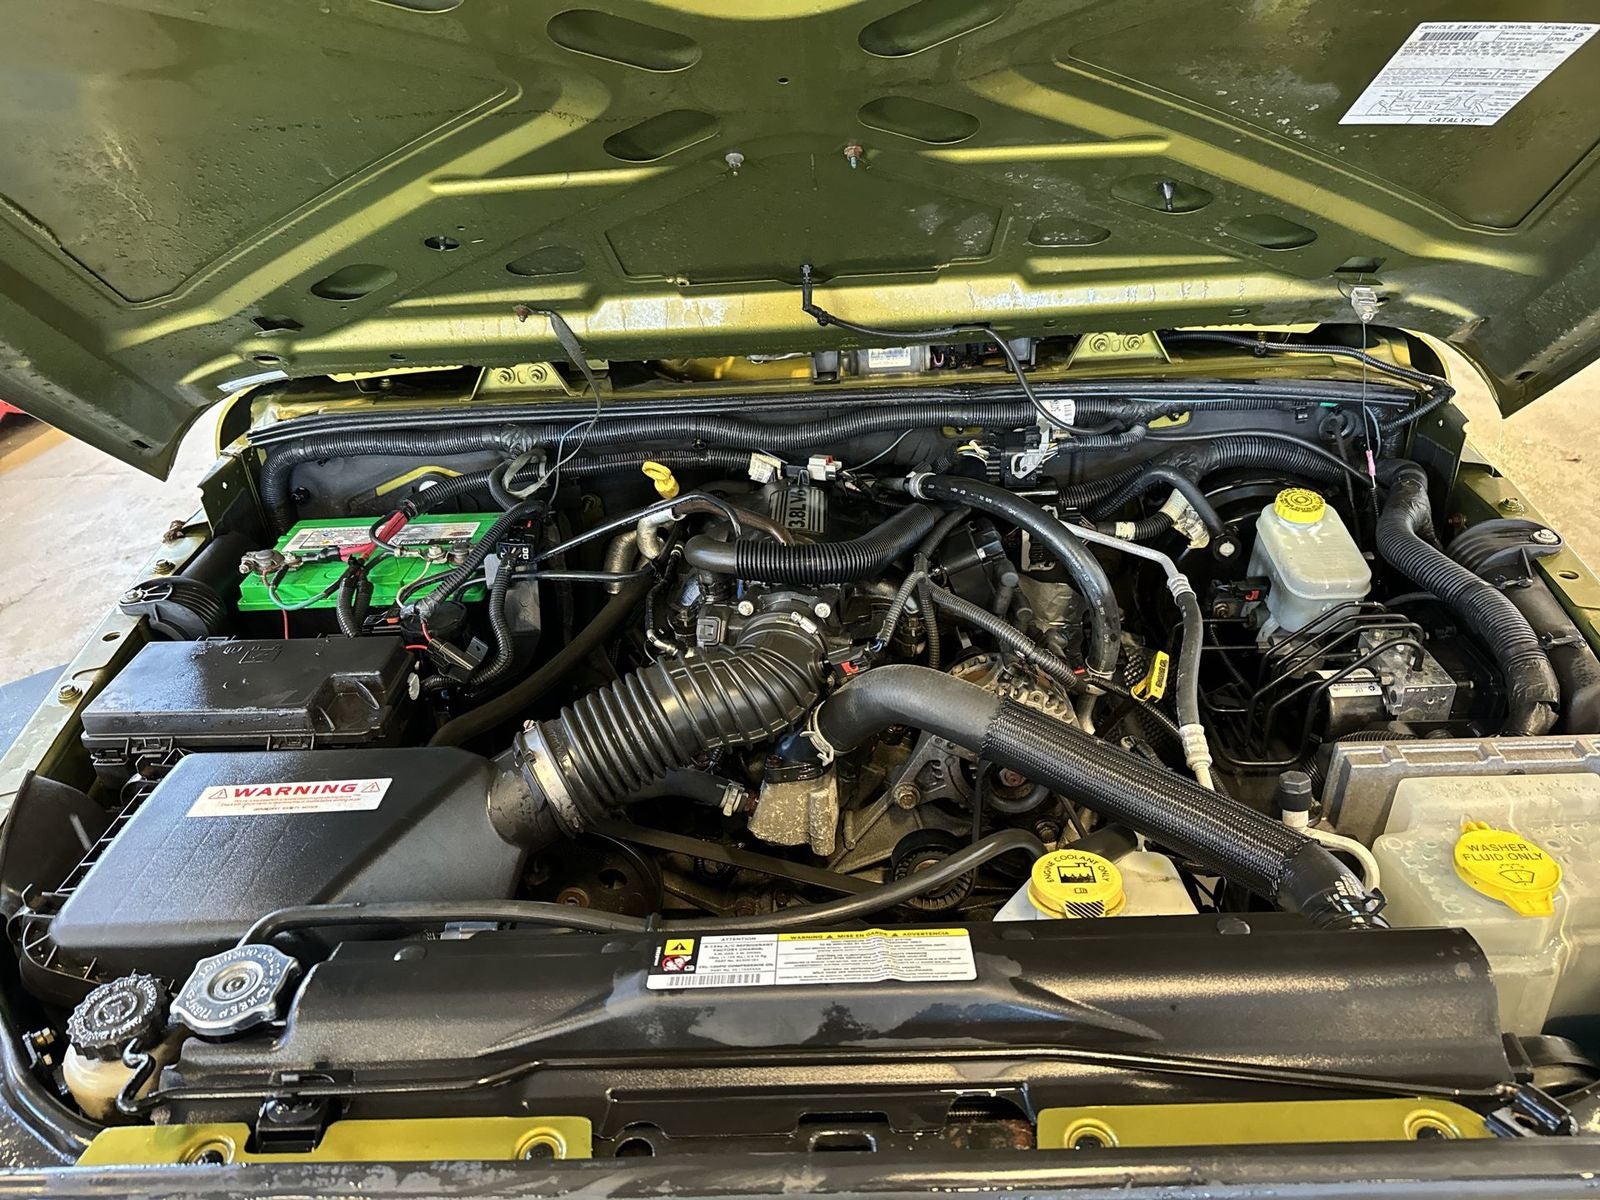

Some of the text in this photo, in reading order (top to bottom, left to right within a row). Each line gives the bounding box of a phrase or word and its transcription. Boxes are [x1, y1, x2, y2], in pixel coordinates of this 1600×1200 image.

[234, 783, 358, 798] WARNING
[1466, 843, 1529, 852] WASHER
[1462, 852, 1543, 861] FLUID ONLY
[1042, 854, 1110, 883] ENGINE COOLANT ONLY
